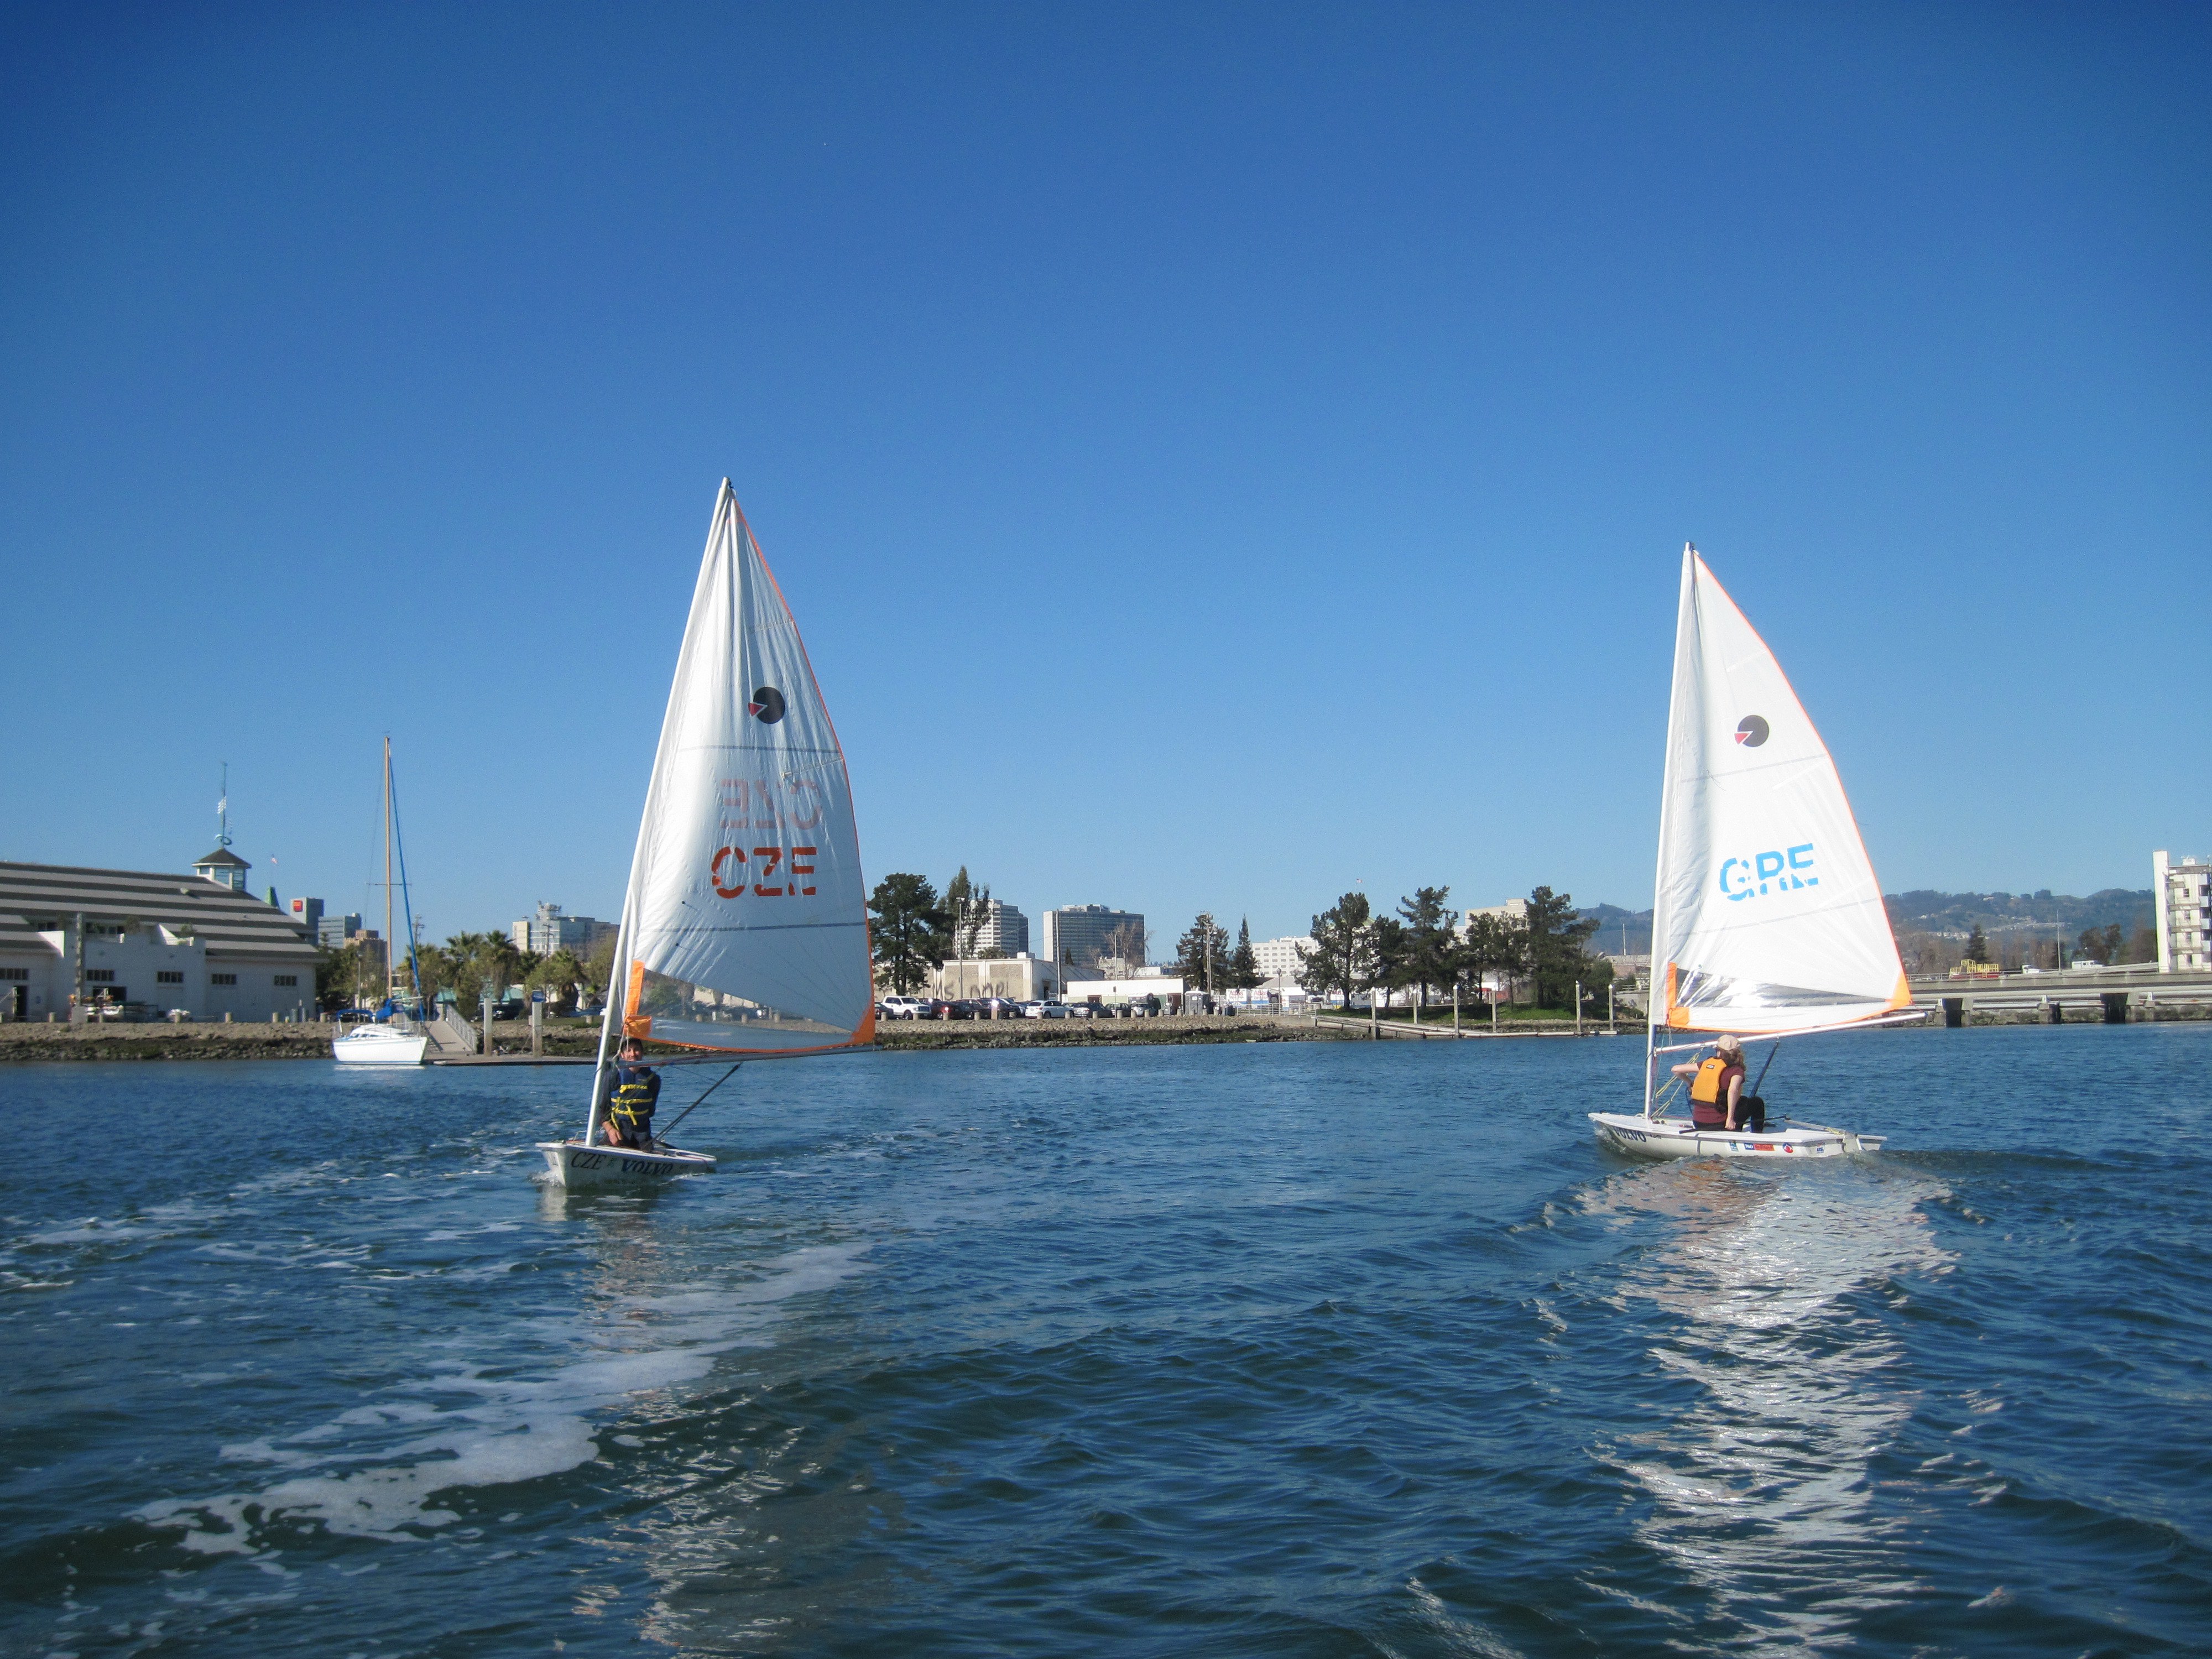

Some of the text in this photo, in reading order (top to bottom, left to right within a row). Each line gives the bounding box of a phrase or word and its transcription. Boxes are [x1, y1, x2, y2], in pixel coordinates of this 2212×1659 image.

[711, 846, 817, 899] CZE
[1613, 1126, 1647, 1142] VOLVO
[571, 1151, 607, 1170] CZE
[620, 1159, 674, 1176] VOLVO
